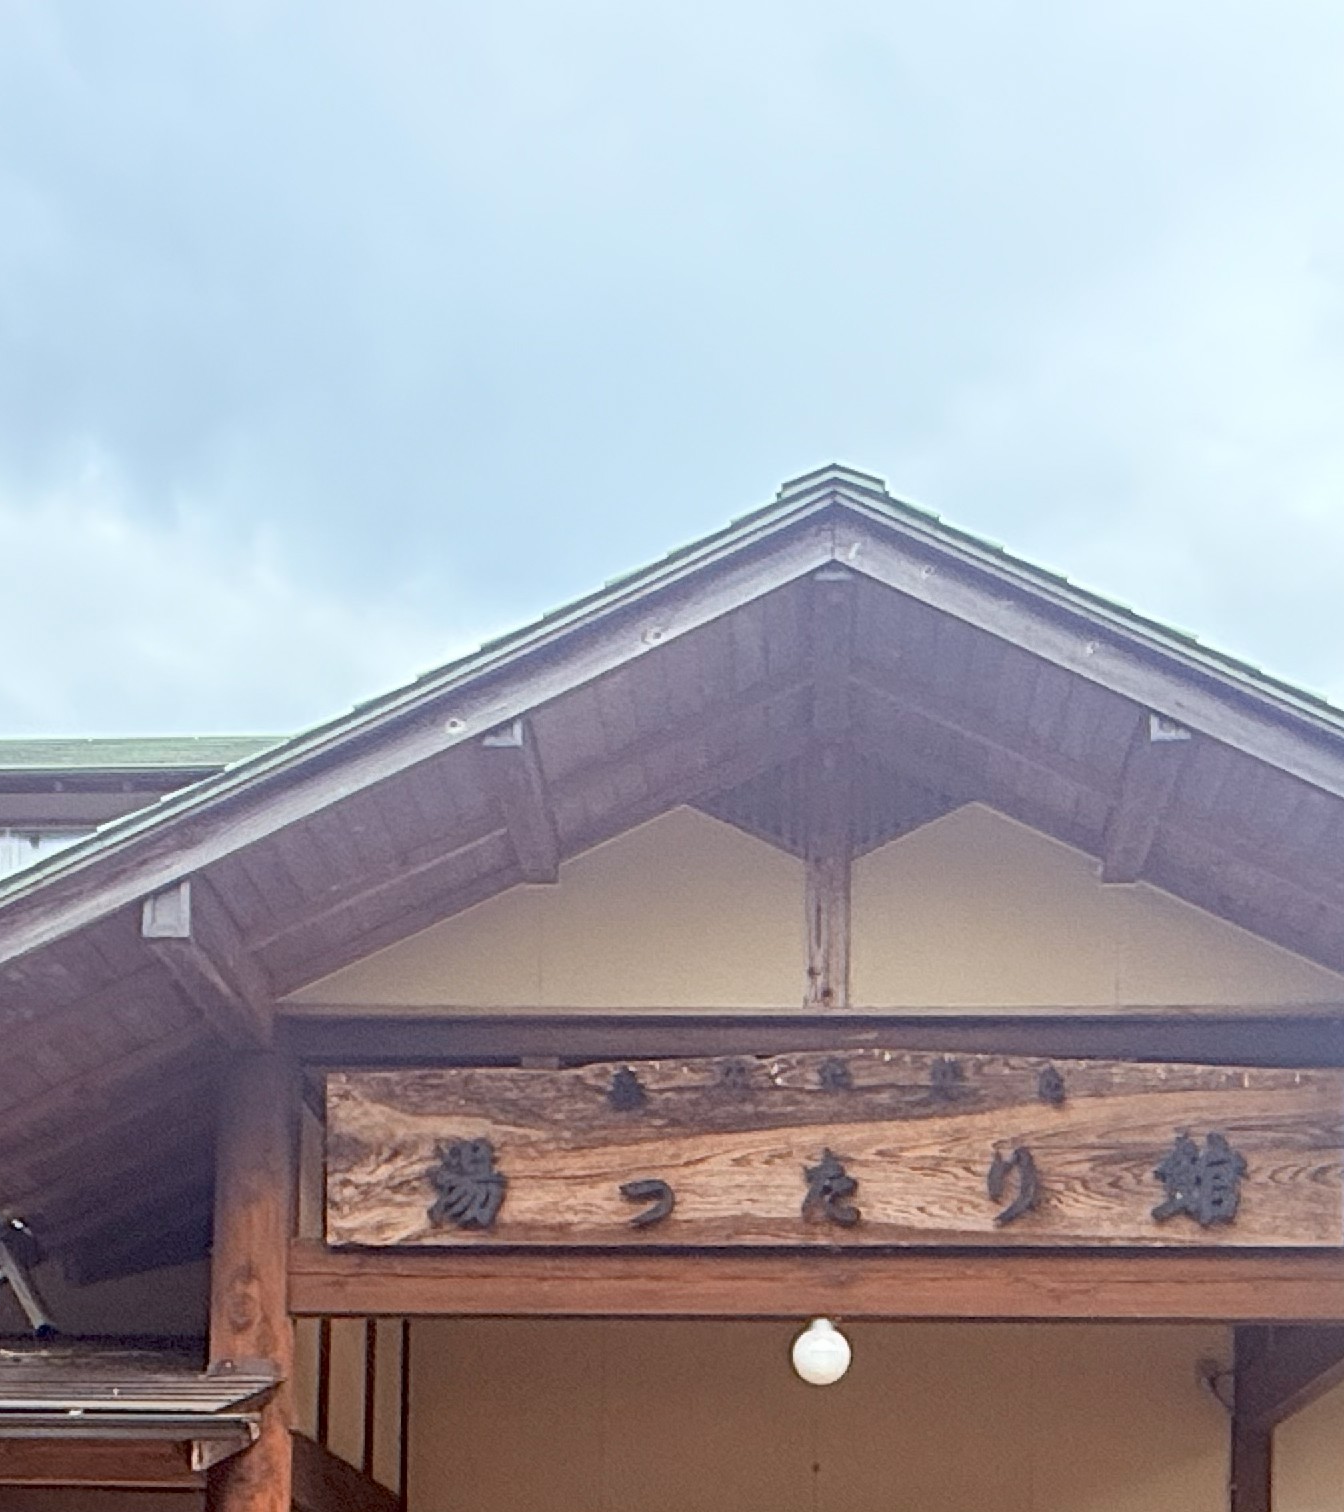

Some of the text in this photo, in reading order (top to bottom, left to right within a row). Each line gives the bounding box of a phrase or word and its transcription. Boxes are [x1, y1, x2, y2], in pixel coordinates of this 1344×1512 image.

[424, 1133, 1247, 1230] 湯ったり館
